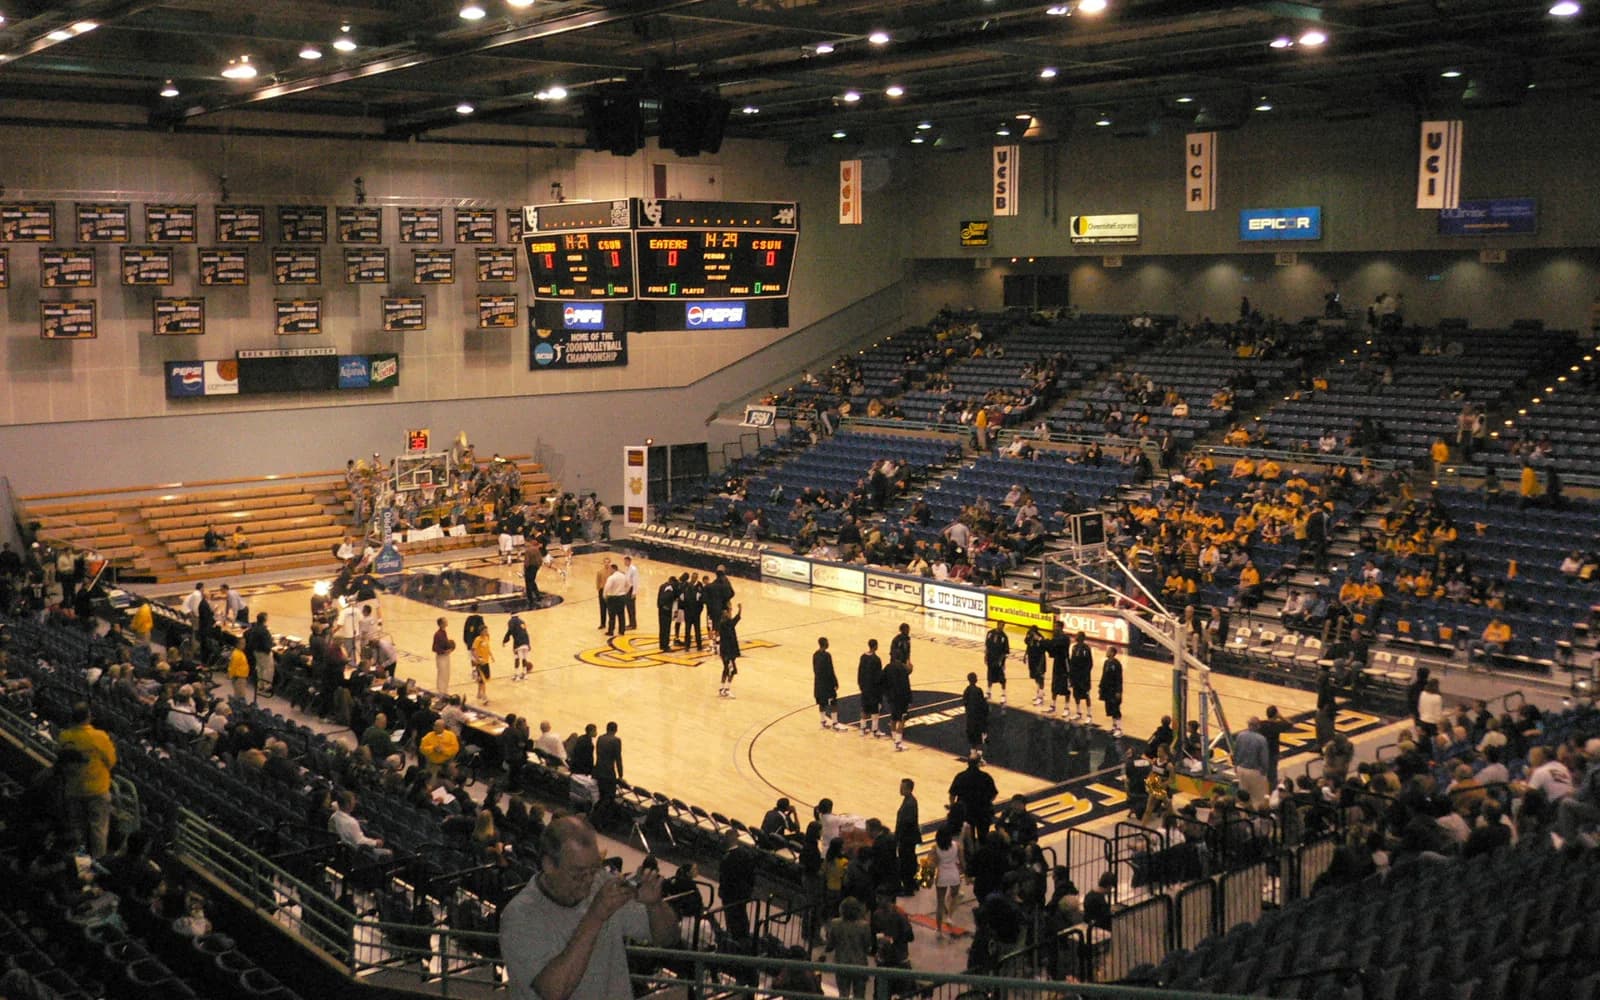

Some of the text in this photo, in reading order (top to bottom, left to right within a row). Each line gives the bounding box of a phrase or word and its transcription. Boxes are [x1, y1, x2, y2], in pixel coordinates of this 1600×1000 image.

[1426, 132, 1441, 195] UCI
[1190, 143, 1202, 202] UCR
[996, 151, 1007, 210] UCSB
[1249, 217, 1310, 230] EPICOR
[650, 239, 688, 249] EATERS
[668, 251, 678, 266] 0
[766, 251, 775, 266] 0
[703, 308, 743, 322] PEPSI
[570, 333, 588, 341] HOME
[602, 332, 614, 340] THE
[566, 352, 618, 363] CHAMPIONSHIP
[938, 592, 983, 611] UC IRVINE
